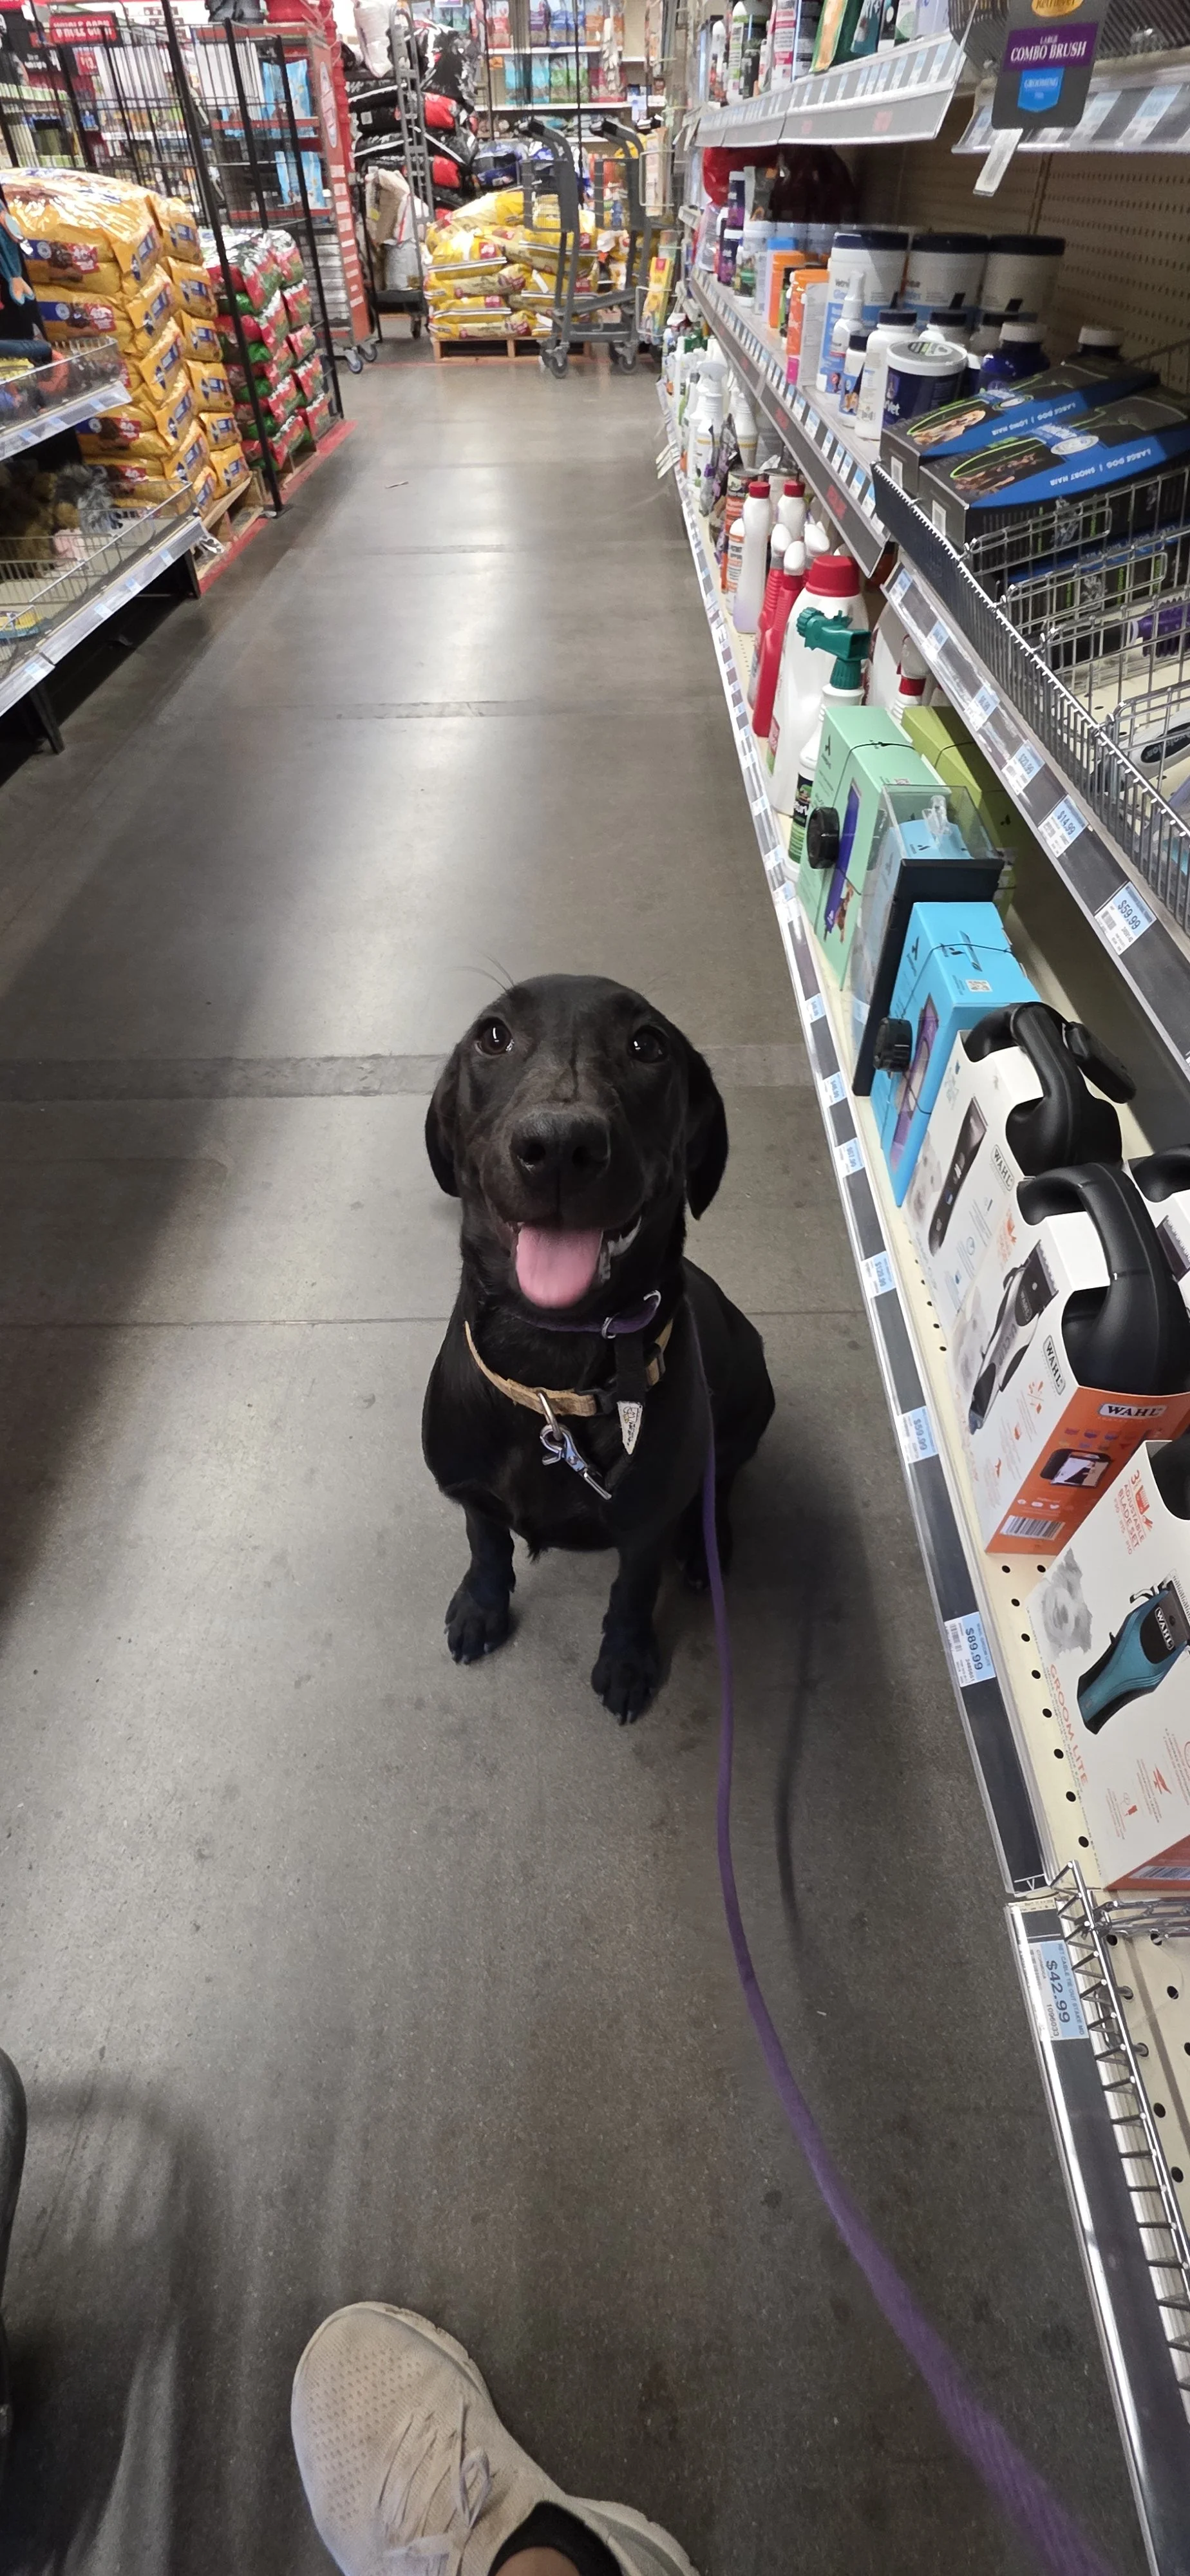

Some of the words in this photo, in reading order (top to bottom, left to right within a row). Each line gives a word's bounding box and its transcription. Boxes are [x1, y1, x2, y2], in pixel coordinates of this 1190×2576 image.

[1010, 44, 1048, 62] COMBO
[1049, 41, 1087, 59] BRUSH
[1037, 410, 1053, 420] DOG
[1106, 457, 1124, 469] DOG
[1126, 448, 1151, 462] LARGE
[1050, 475, 1068, 486] HAIR
[1071, 467, 1095, 481] SHORT
[1057, 810, 1076, 836] $14.99
[1117, 899, 1142, 931] $59.99
[994, 1148, 1012, 1188] WAHL
[1045, 1341, 1062, 1388] WAHL
[1108, 1405, 1161, 1417] WAHL
[1118, 1488, 1132, 1528] BLADE
[1130, 1526, 1140, 1549] SET
[1124, 1484, 1145, 1542] ADJUSTABLE
[1157, 1611, 1173, 1647] WAHL
[965, 1627, 984, 1671] $89.99
[1050, 1663, 1073, 1740] GROOM
[1072, 1743, 1088, 1787] LITE
[1047, 1960, 1070, 2023] $42.99
[1061, 1956, 1070, 1976] CABLE
[1072, 2003, 1082, 2023] STAKE
[1046, 2003, 1059, 2037] 1096033
